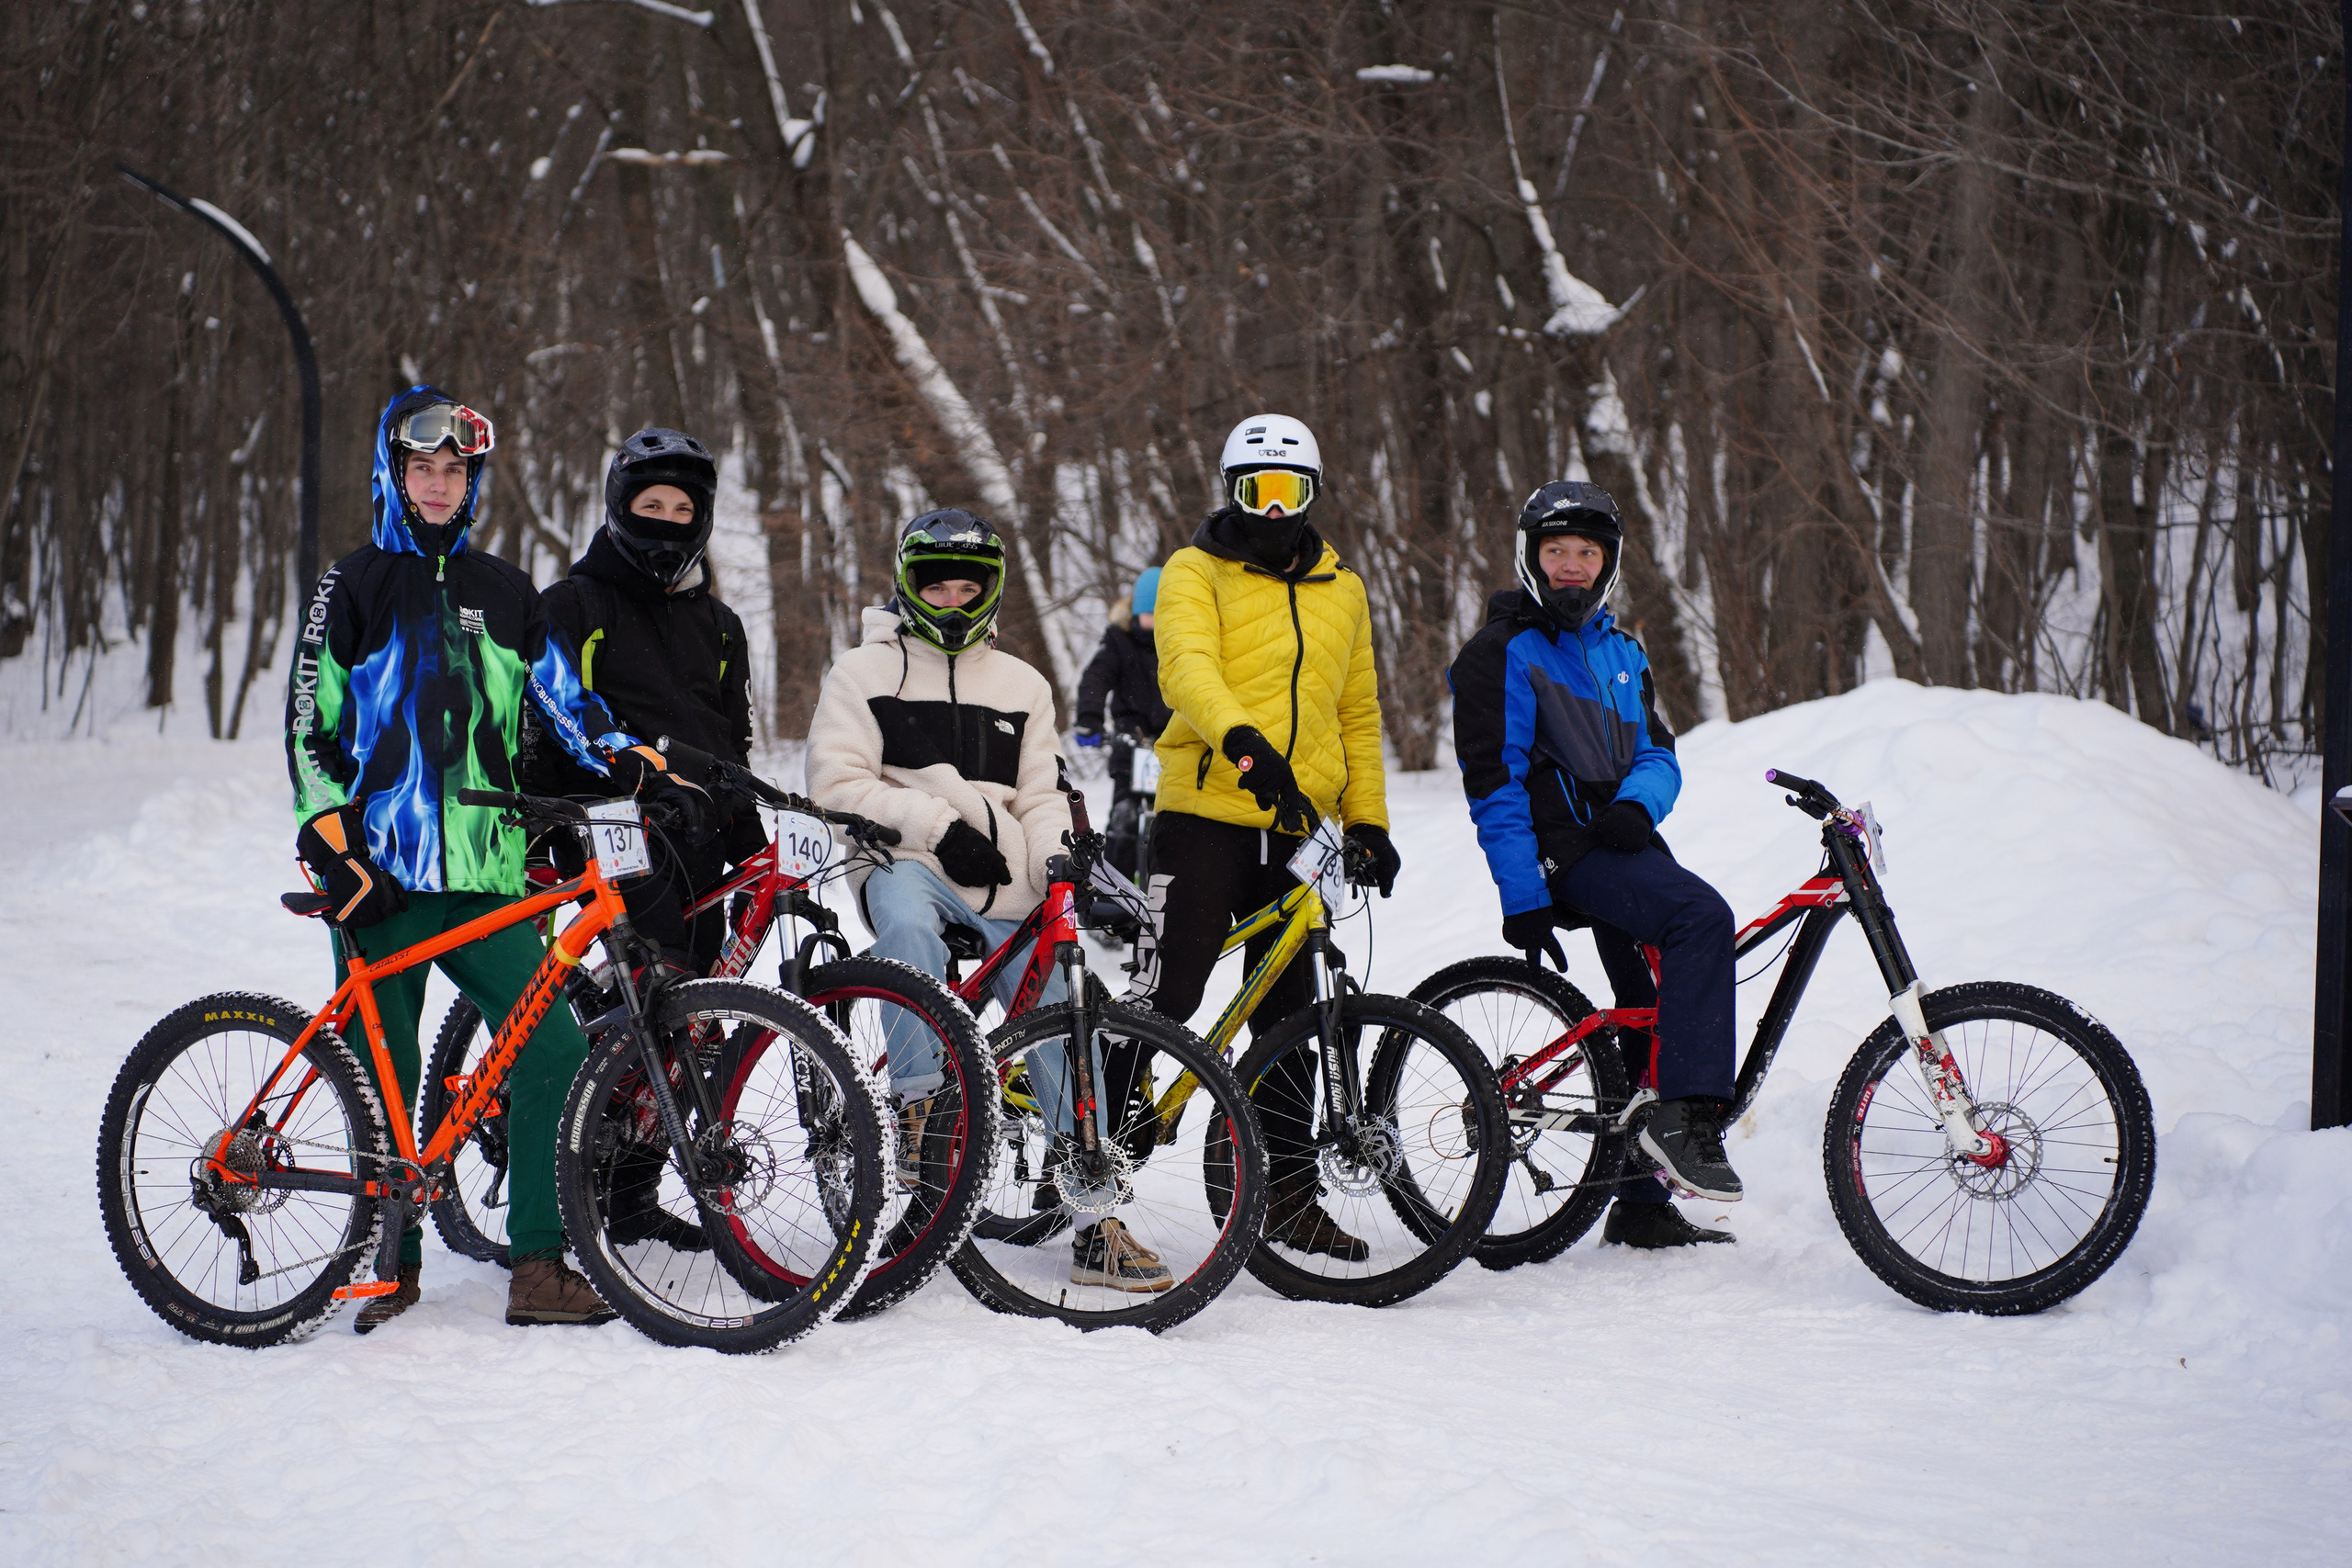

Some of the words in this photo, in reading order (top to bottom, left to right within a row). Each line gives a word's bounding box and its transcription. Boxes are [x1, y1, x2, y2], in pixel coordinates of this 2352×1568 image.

[303, 566, 342, 643] ROKIT
[292, 652, 320, 734] ROKIT
[605, 826, 634, 853] 137
[788, 831, 823, 865] 140
[369, 950, 411, 973] CATALYST
[204, 1010, 276, 1026] MAXXIS
[697, 1010, 730, 1021] 29
[1012, 1029, 1026, 1039] ALL
[732, 1010, 826, 1069] INFERNO
[794, 1043, 812, 1094] XCM
[1326, 1045, 1341, 1081] RUSH
[570, 1078, 597, 1155] AGGRESSOR
[654, 1082, 687, 1146] ROCKSHOX
[120, 1119, 139, 1229] INFERNO
[130, 1229, 152, 1261] 29
[812, 1218, 862, 1303] MAXXIS
[616, 1268, 708, 1327] INFERNO
[710, 1318, 743, 1329] 29
[234, 1323, 258, 1334] DHR
[257, 1311, 294, 1331] MINION
